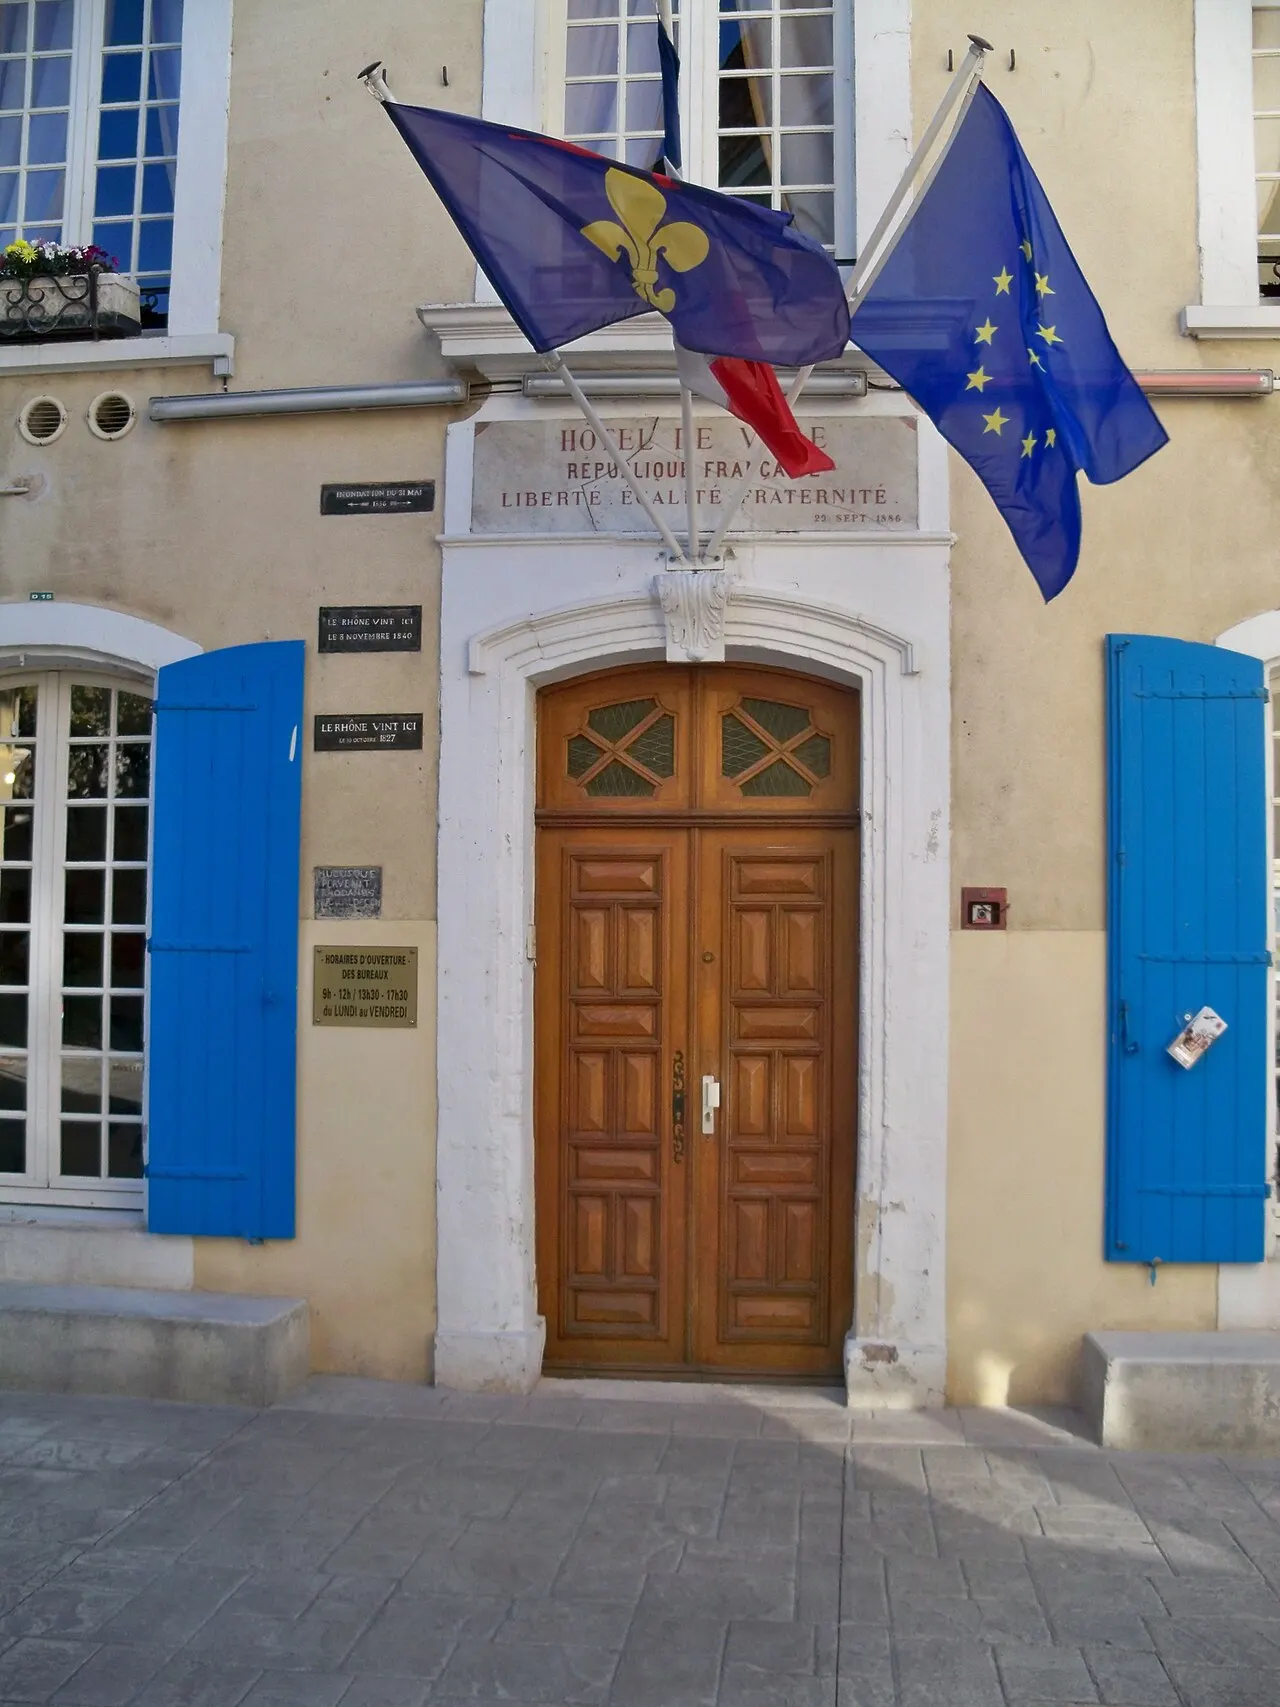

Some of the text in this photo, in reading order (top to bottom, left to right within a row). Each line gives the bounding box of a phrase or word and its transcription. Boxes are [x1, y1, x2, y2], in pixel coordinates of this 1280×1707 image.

[560, 421, 653, 452] HÔEL
[567, 456, 820, 481] RÉPULIQU FRAÇA
[502, 485, 601, 507] LIBERTÉ
[622, 484, 721, 505] ÉALITÉ
[327, 618, 337, 626] LE
[342, 615, 370, 626] RHÔNE
[393, 632, 413, 640] 1840
[321, 719, 417, 732] LE RHÔNE VINT ICI
[379, 734, 396, 742] 1827
[325, 954, 357, 964] HORAIRES
[360, 954, 406, 965] D'OUVERTURE
[342, 969, 389, 980] DES BUREAUX
[322, 988, 331, 999] 9h
[339, 989, 351, 1000] 12h
[359, 989, 380, 1000] 13h30
[387, 989, 408, 1001] 17h30
[323, 1005, 408, 1018] du LUNDI au VENDREDI
